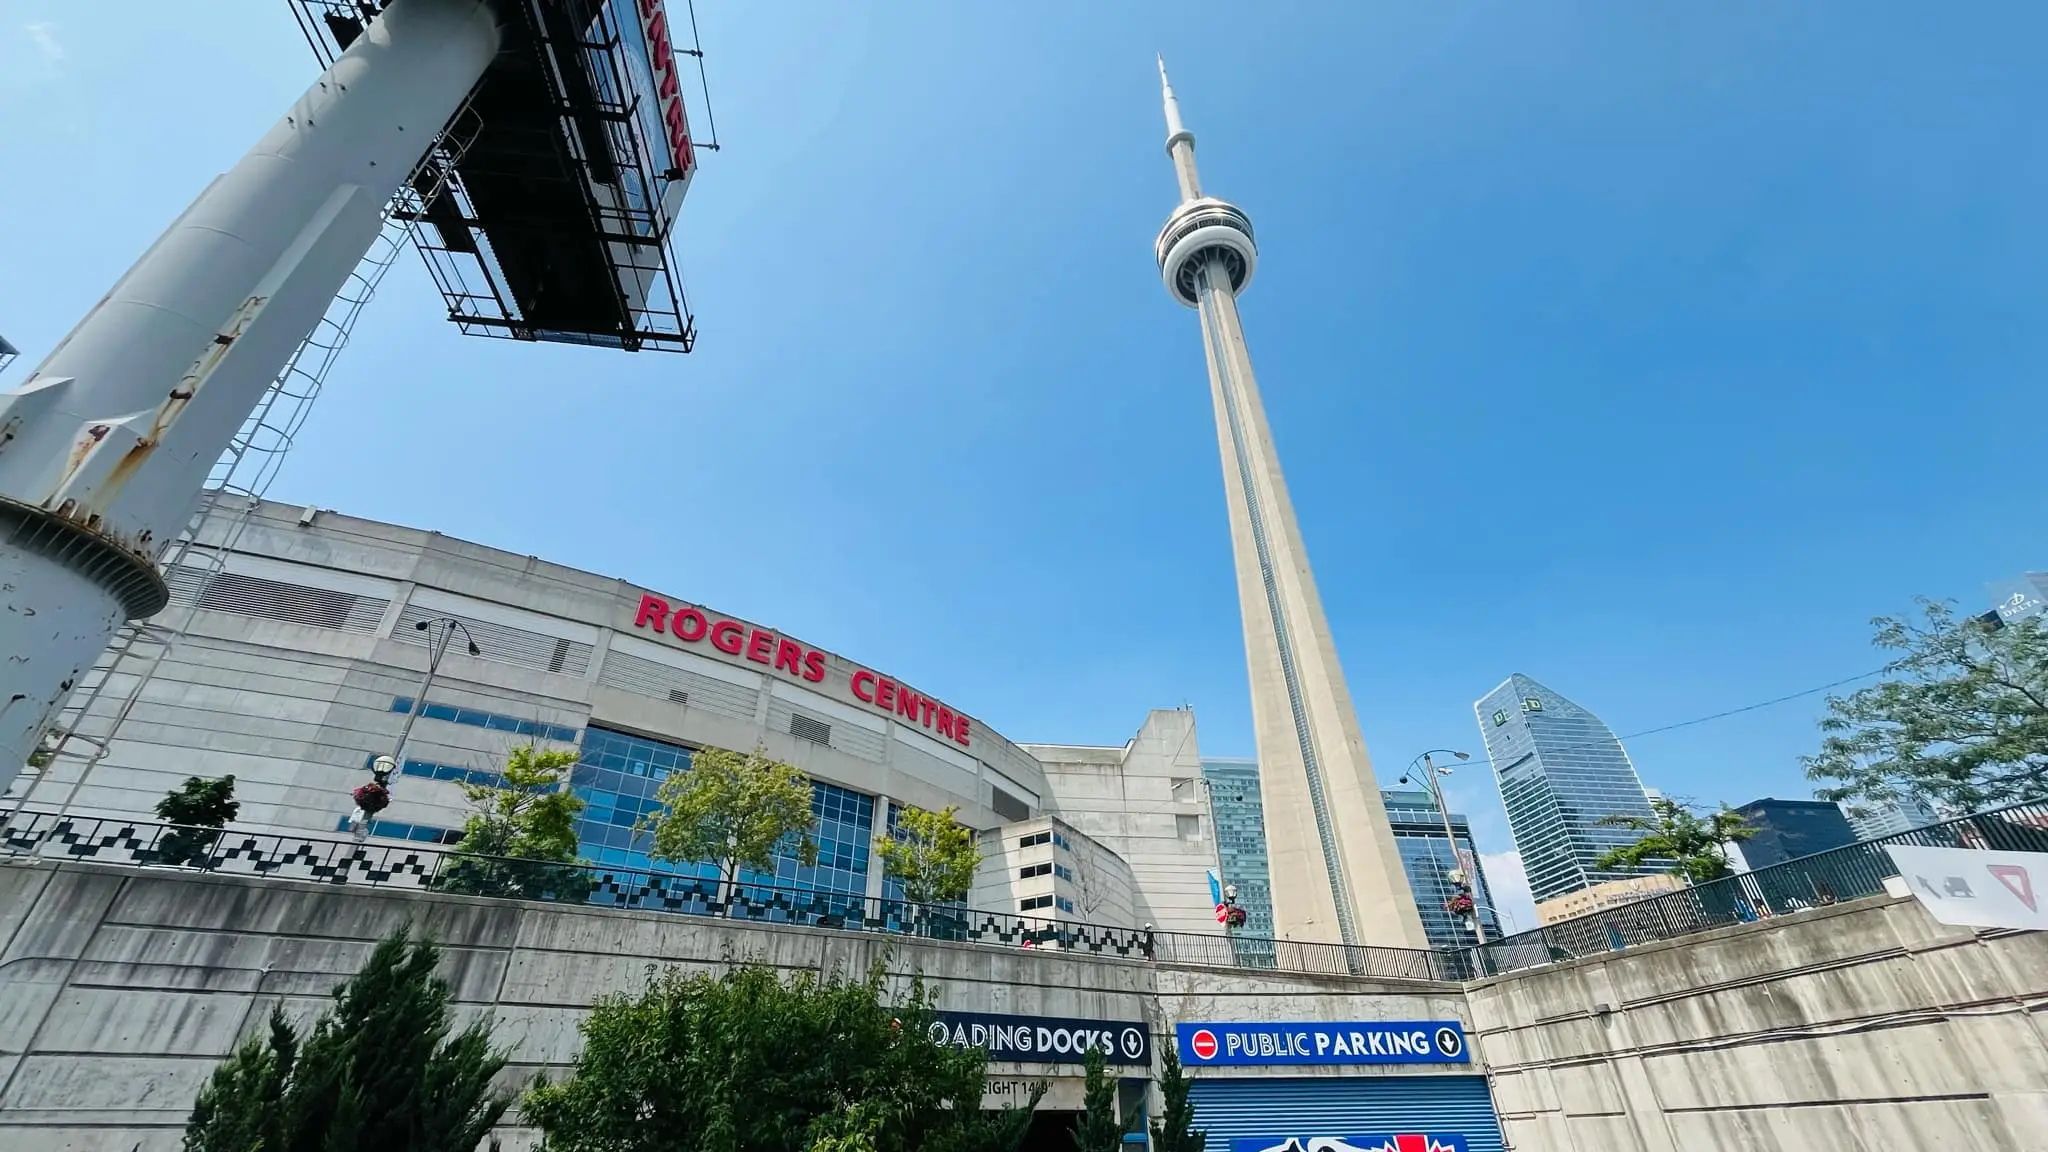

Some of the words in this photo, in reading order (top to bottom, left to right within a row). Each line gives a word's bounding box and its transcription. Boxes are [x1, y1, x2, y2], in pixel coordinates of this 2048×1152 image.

[634, 592, 826, 683] ROGERS
[850, 669, 971, 746] CENTRE
[1036, 1026, 1115, 1056] DOCKS
[1225, 1031, 1311, 1057] PUBLIC
[1314, 1031, 1431, 1056] PARKING
[981, 1081, 1019, 1094] EIGHT
